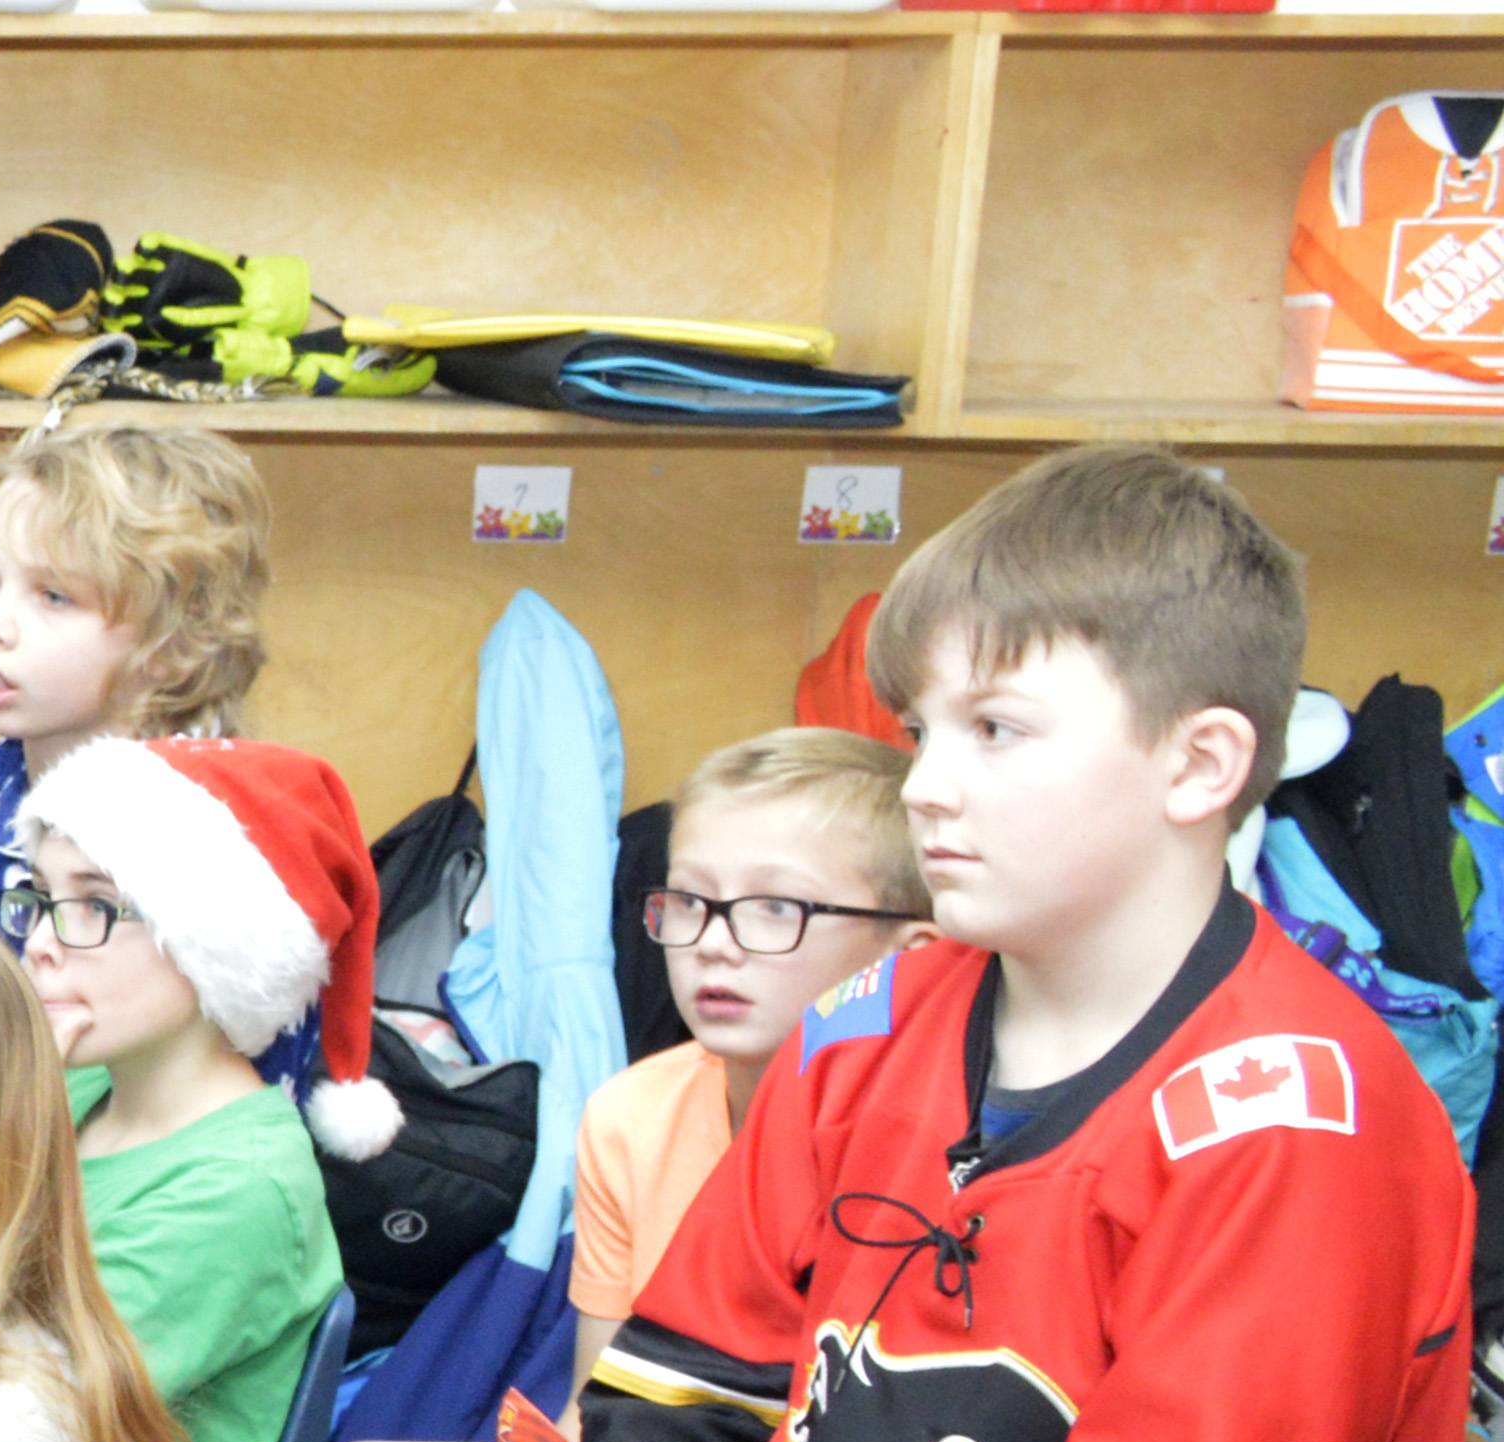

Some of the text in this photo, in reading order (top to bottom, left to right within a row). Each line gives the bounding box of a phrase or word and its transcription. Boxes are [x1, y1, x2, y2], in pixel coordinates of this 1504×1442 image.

[1404, 233, 1464, 280] THE
[514, 483, 529, 508] 7
[836, 475, 859, 510] 8
